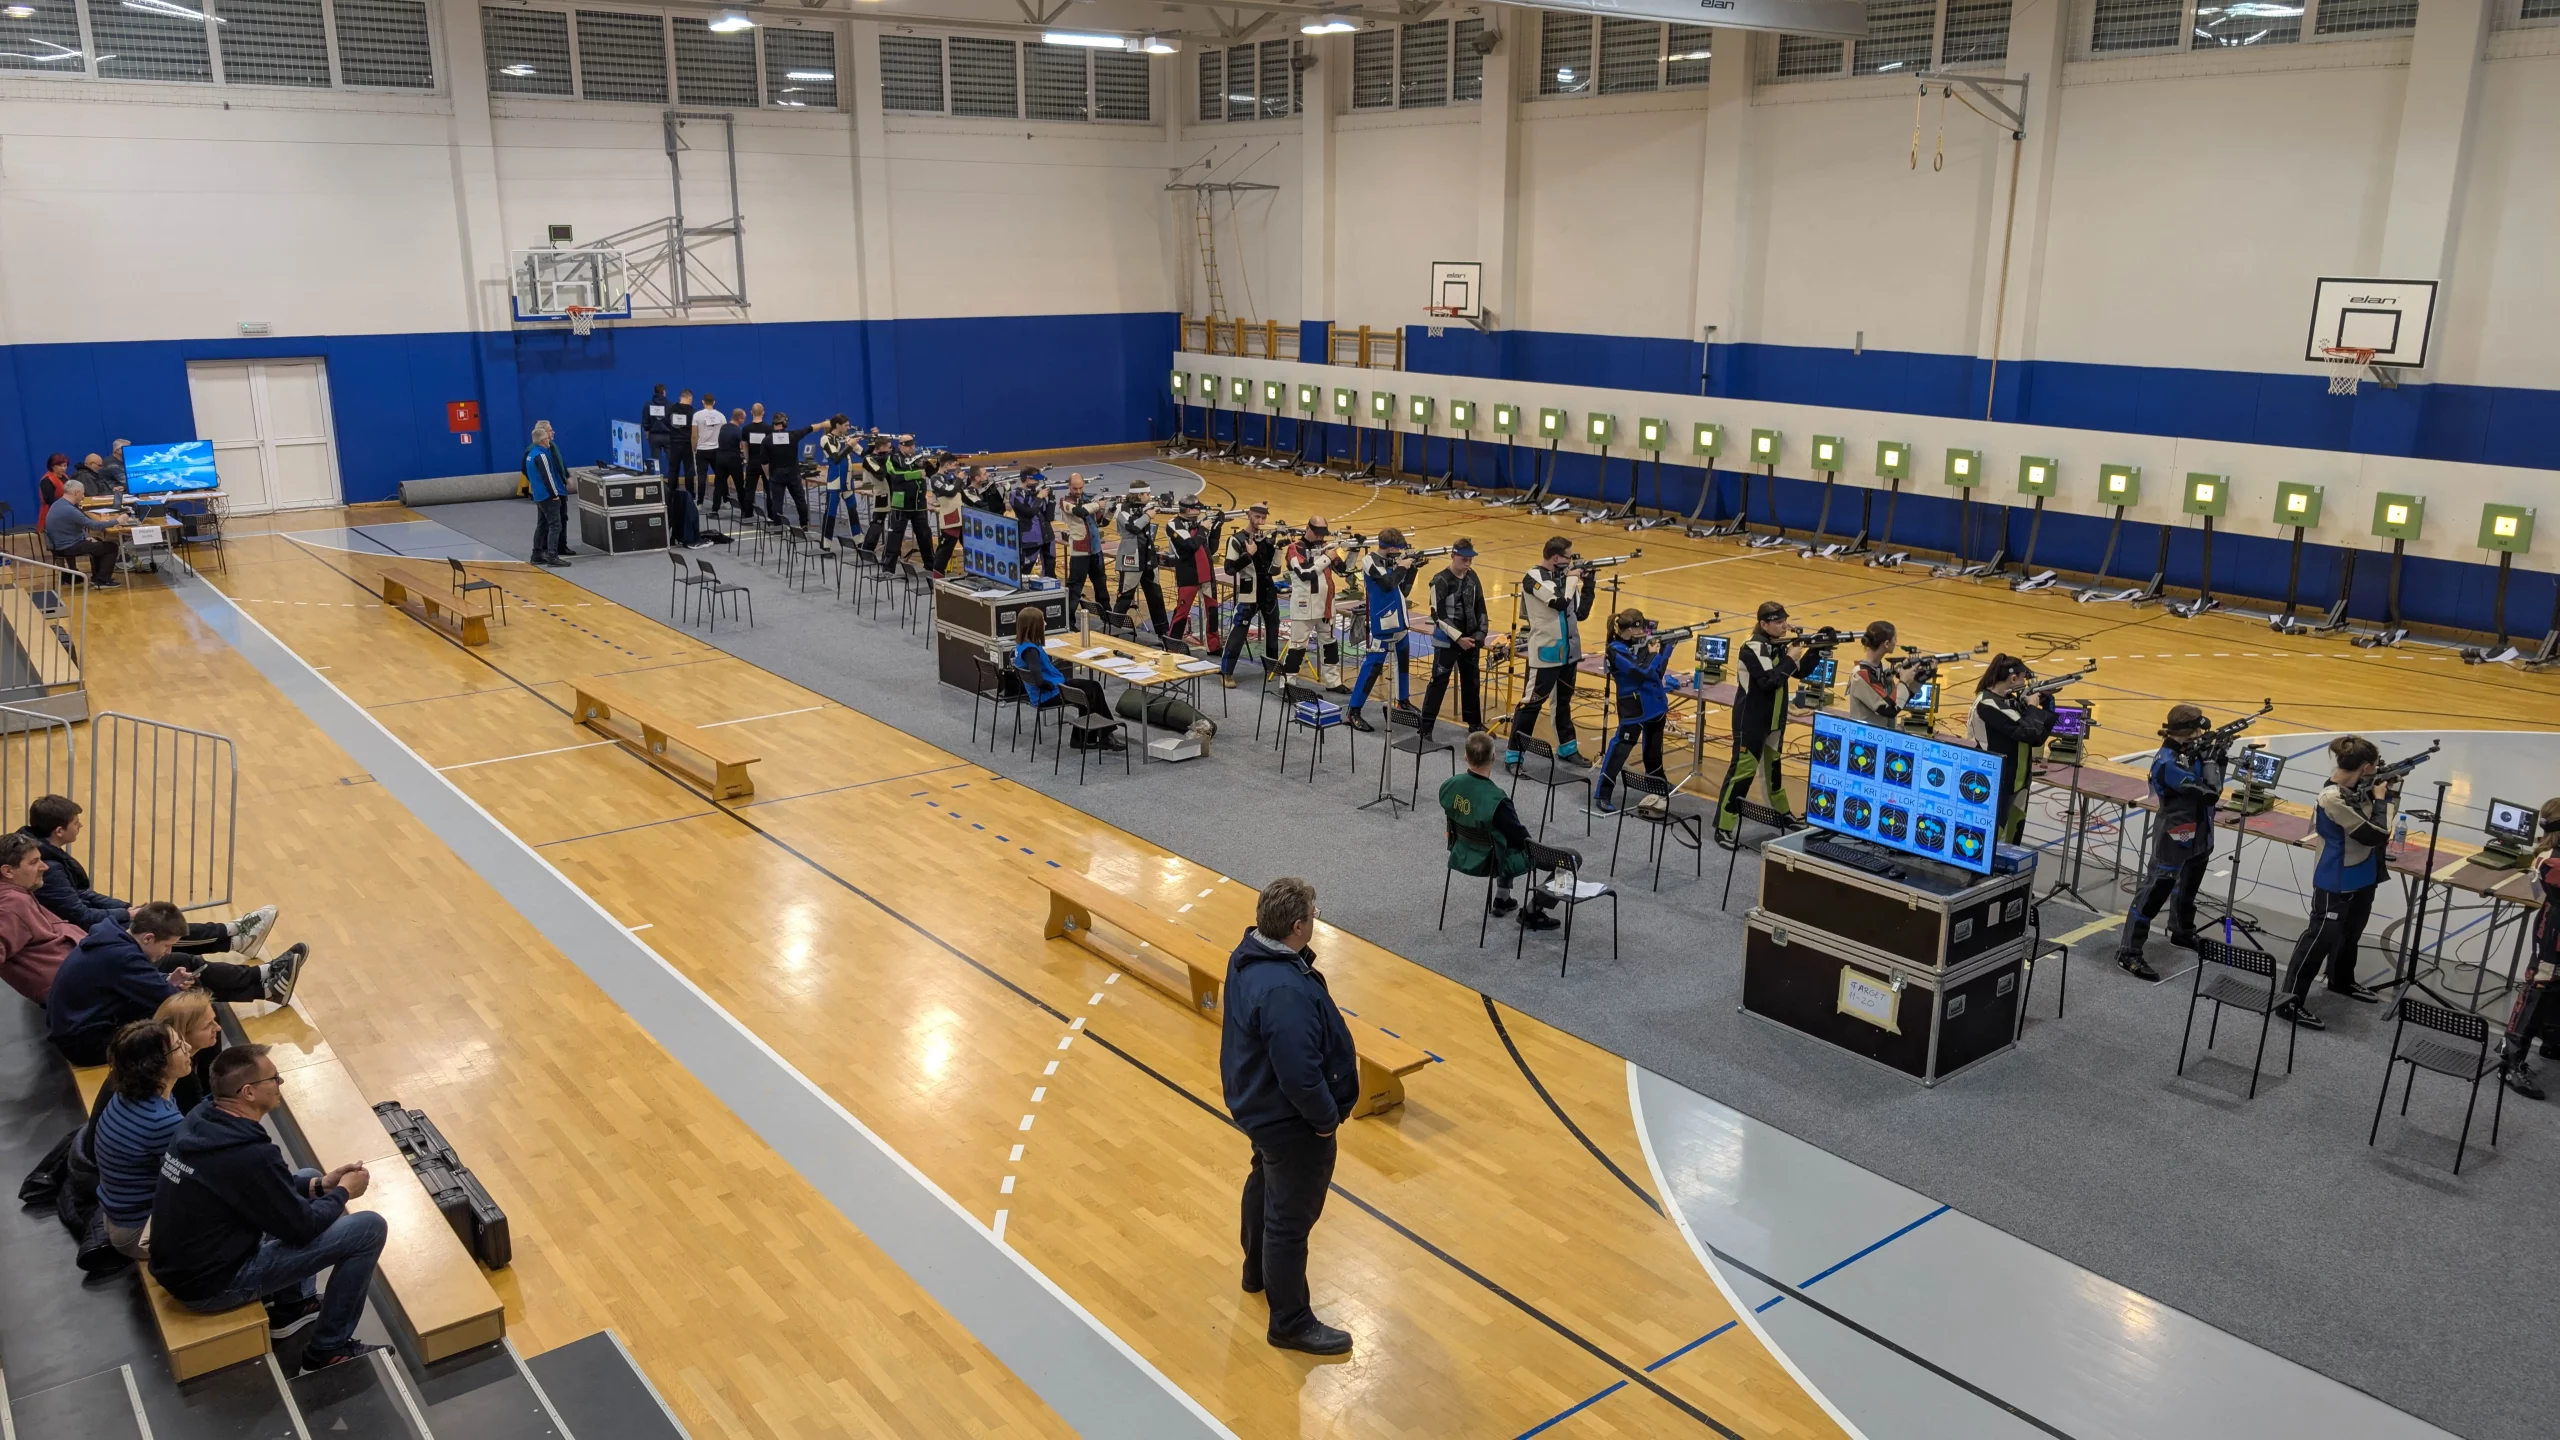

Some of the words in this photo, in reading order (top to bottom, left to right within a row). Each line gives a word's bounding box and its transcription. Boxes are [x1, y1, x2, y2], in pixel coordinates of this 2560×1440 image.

[1701, 0, 1734, 10] elan
[2349, 295, 2397, 304] elan
[1832, 723, 1848, 733] TEK
[1867, 732, 1883, 742] SLO
[1904, 741, 1920, 751] ZEL
[1941, 750, 1958, 760] SLO
[1981, 759, 1997, 770] ZEL
[1827, 777, 1843, 787] LOK
[1863, 787, 1877, 797] KRI
[1453, 794, 1470, 815] RO
[1898, 797, 1915, 807] LOK
[1936, 806, 1953, 816] SLO
[1974, 816, 1992, 827] LOK
[1850, 981, 1886, 1000] TARGET
[180, 1162, 195, 1175] KLUB
